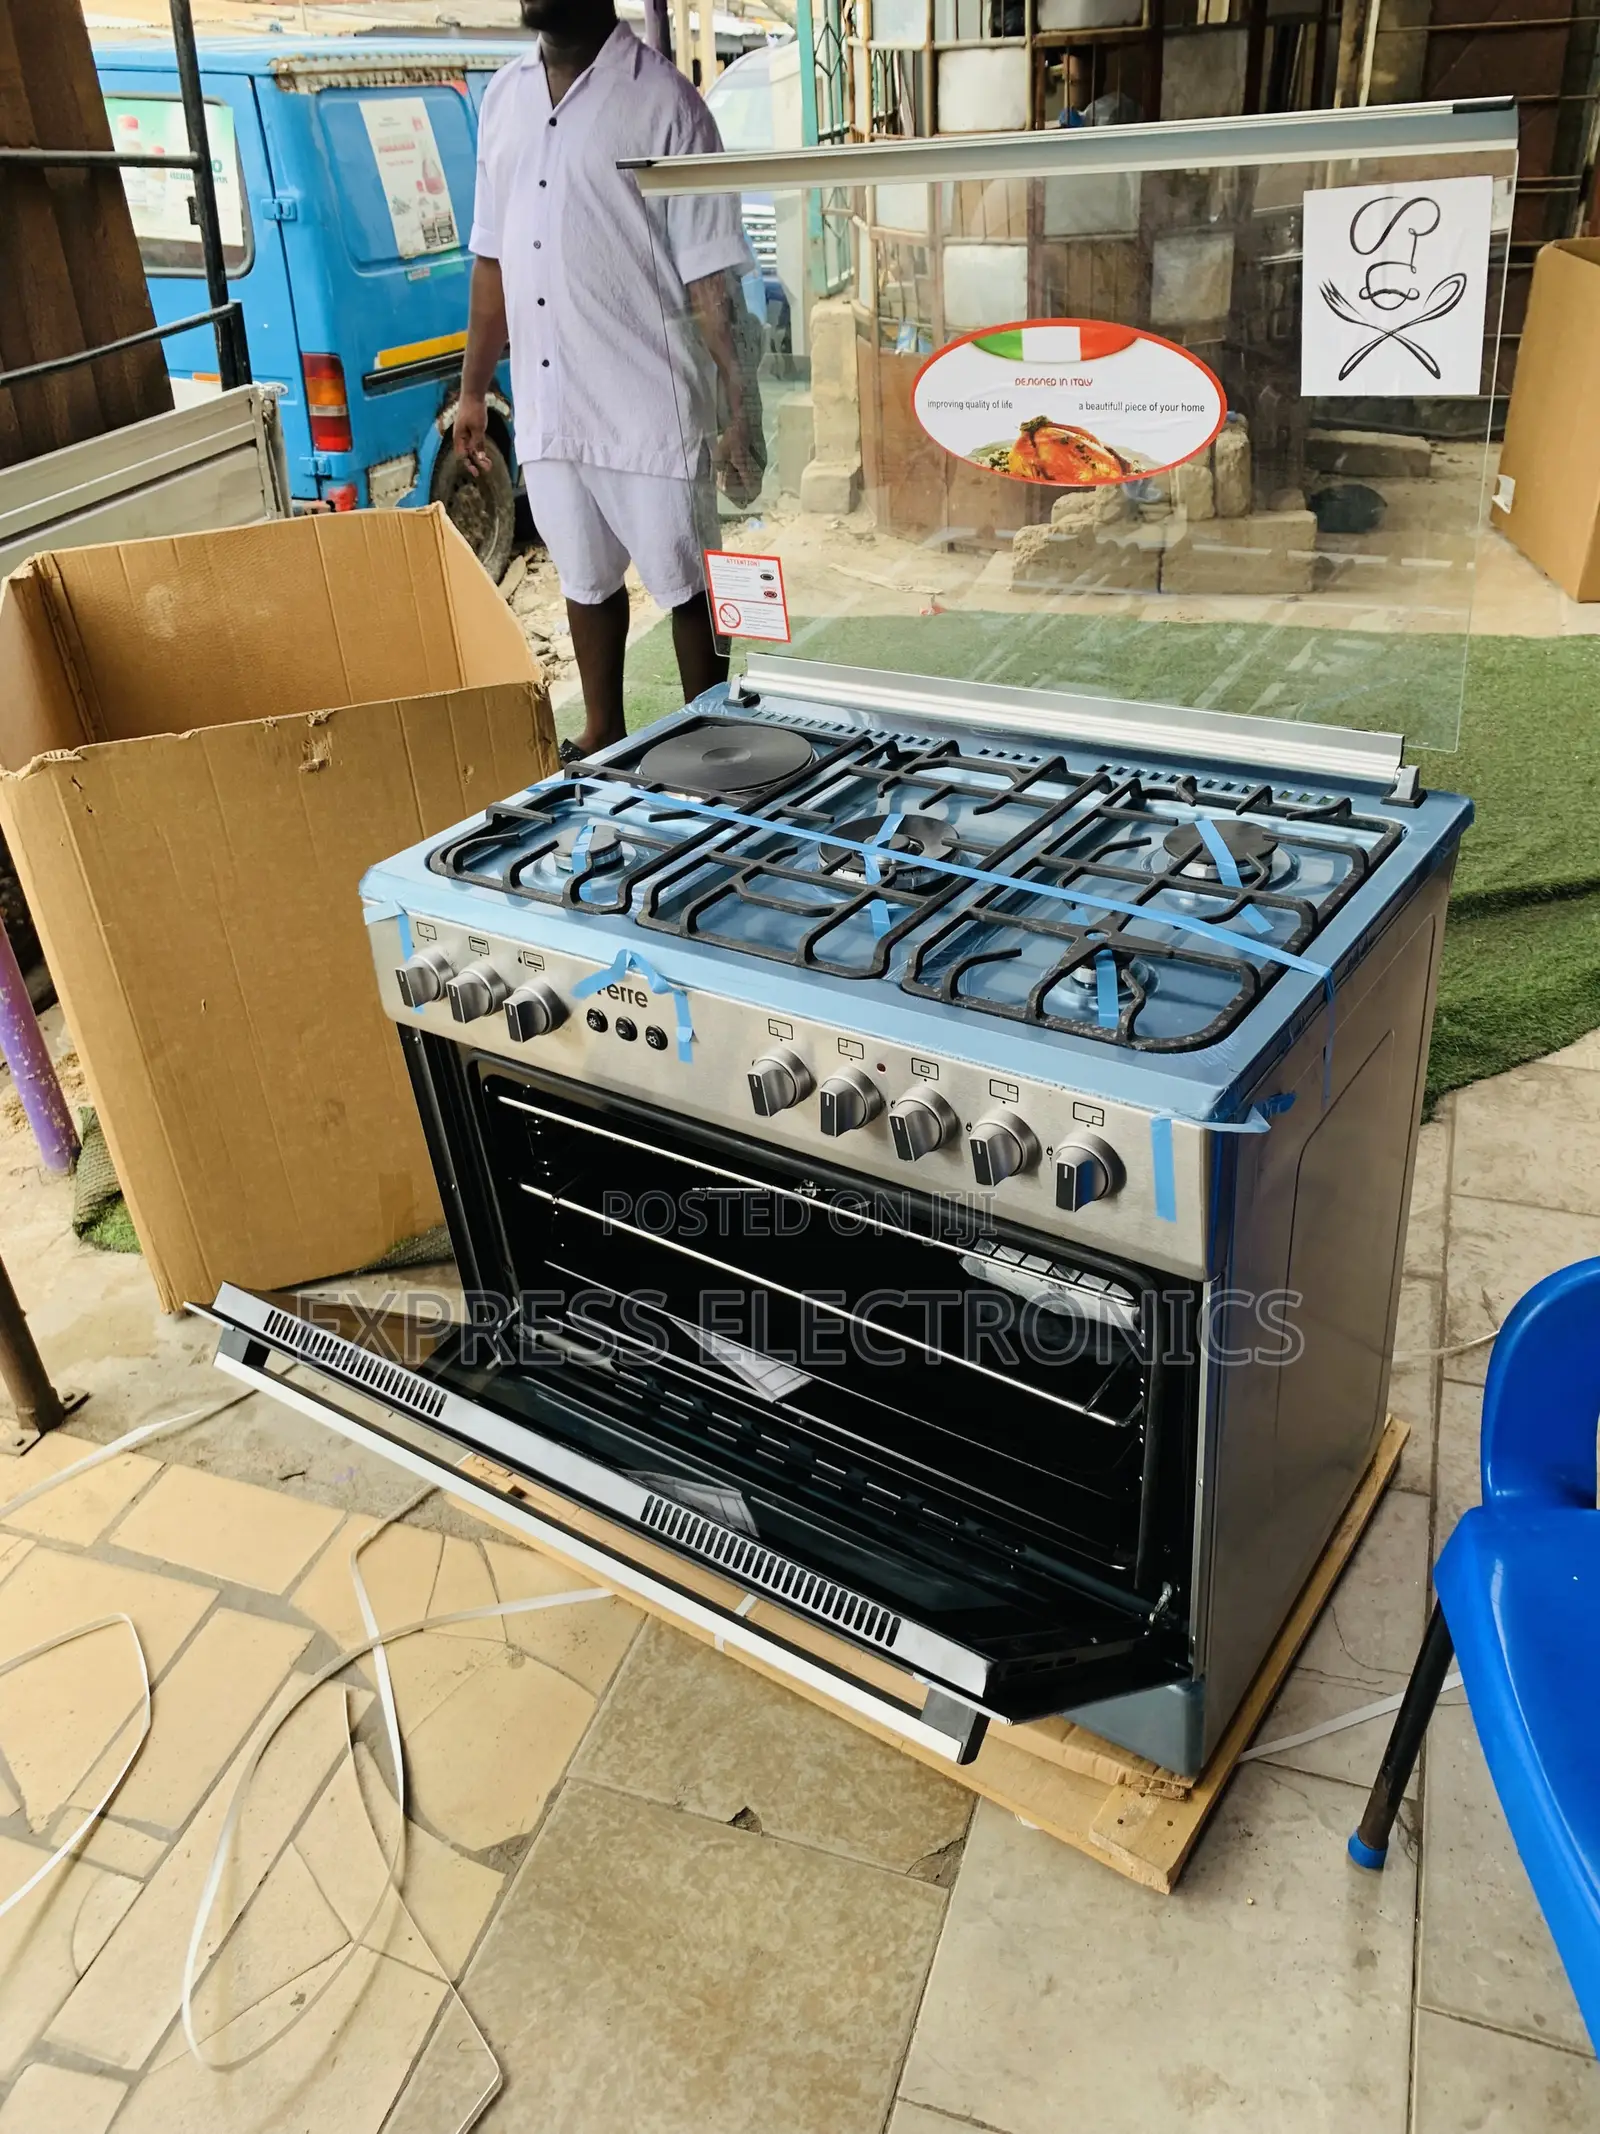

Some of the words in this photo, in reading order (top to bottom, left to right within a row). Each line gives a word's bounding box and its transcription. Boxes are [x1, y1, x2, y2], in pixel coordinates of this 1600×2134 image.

[1015, 378, 1056, 386] DESIGNED
[1060, 378, 1068, 386] IN
[1071, 378, 1093, 386] ITALY
[927, 399, 964, 410] improving
[965, 399, 990, 410] quality
[992, 400, 1000, 409] of
[1001, 400, 1013, 409] life
[1085, 401, 1123, 411] beautifull
[1125, 402, 1147, 413] piece
[1149, 402, 1158, 412] of
[1160, 403, 1179, 413] your
[1181, 401, 1205, 412] home
[596, 983, 649, 1008] erre
